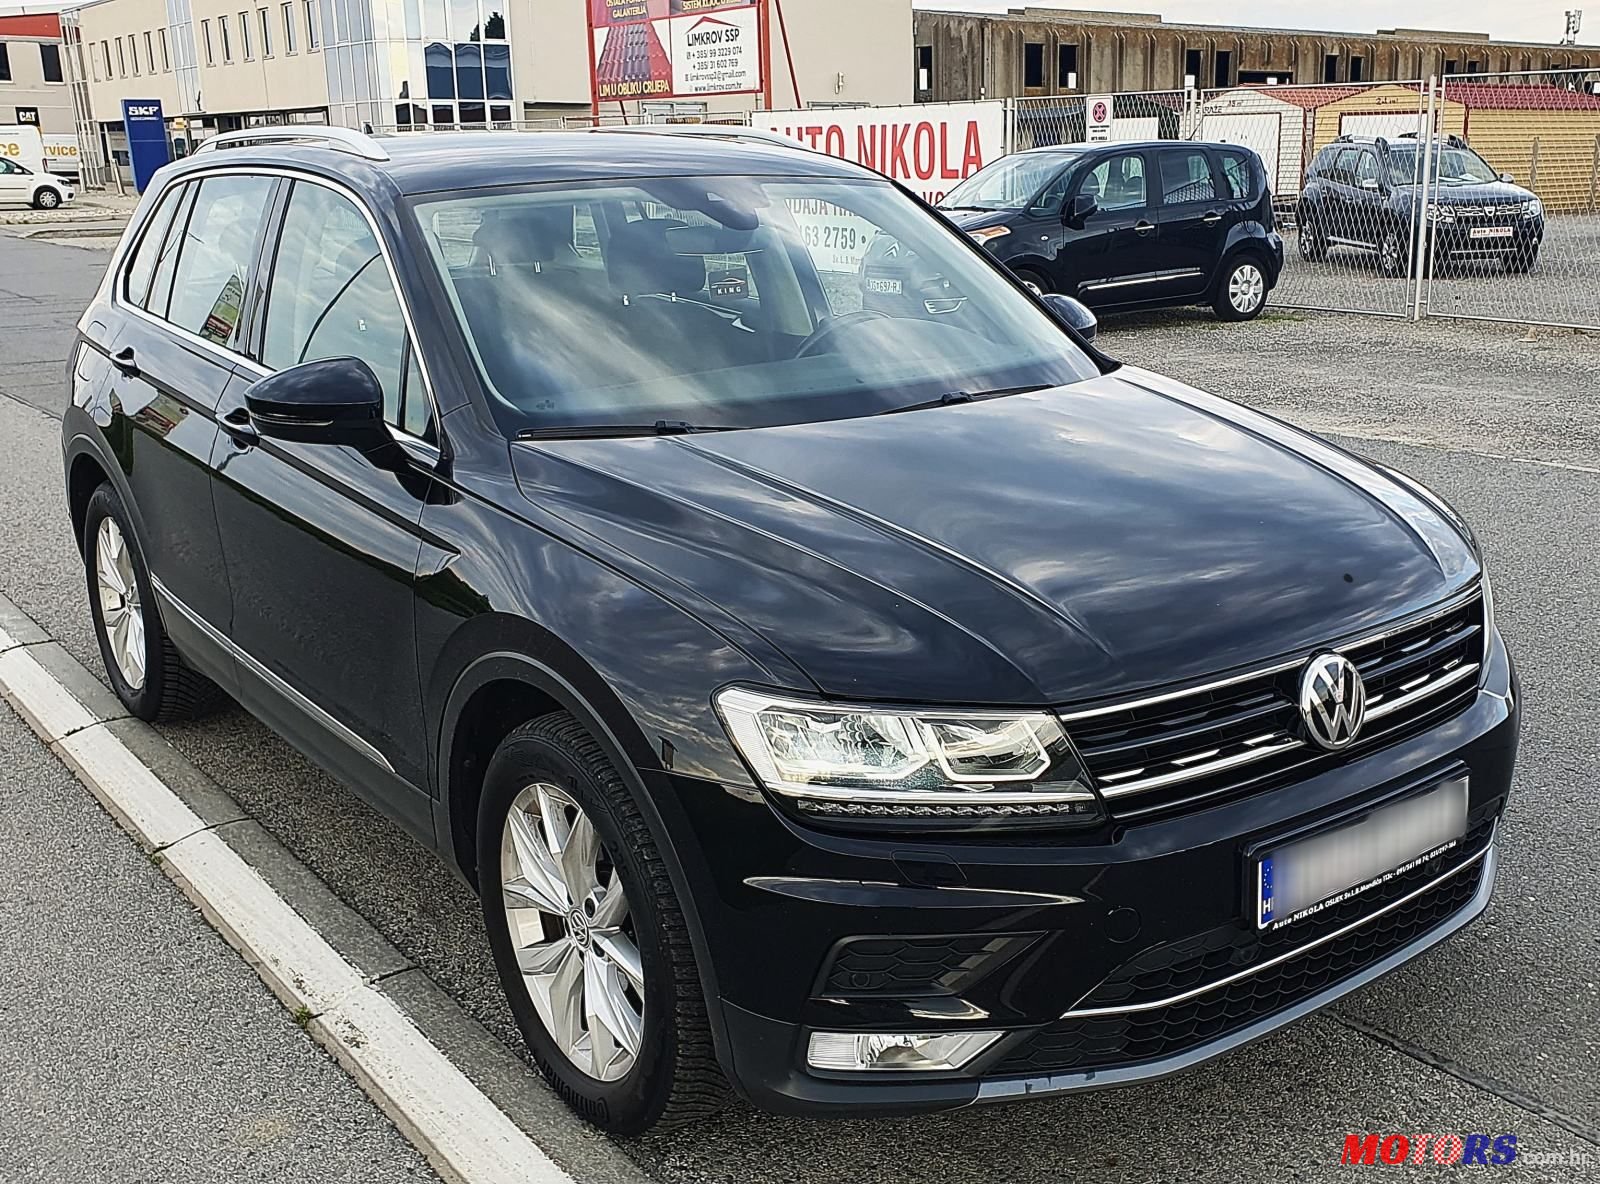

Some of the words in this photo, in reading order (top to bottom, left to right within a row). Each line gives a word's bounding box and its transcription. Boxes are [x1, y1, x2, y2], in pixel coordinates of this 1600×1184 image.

[687, 30, 723, 46] LIMKROV
[724, 28, 740, 42] SSP
[599, 84, 611, 97] LIM
[611, 83, 617, 95] U
[617, 81, 642, 95] OBLIKU
[19, 111, 36, 121] CAT
[128, 106, 159, 116] SKF
[858, 120, 983, 180] NIKOLA
[823, 225, 856, 250] 2759
[717, 286, 742, 295] KING
[1272, 917, 1292, 931] Auto
[1293, 903, 1324, 922] NIKOLA
